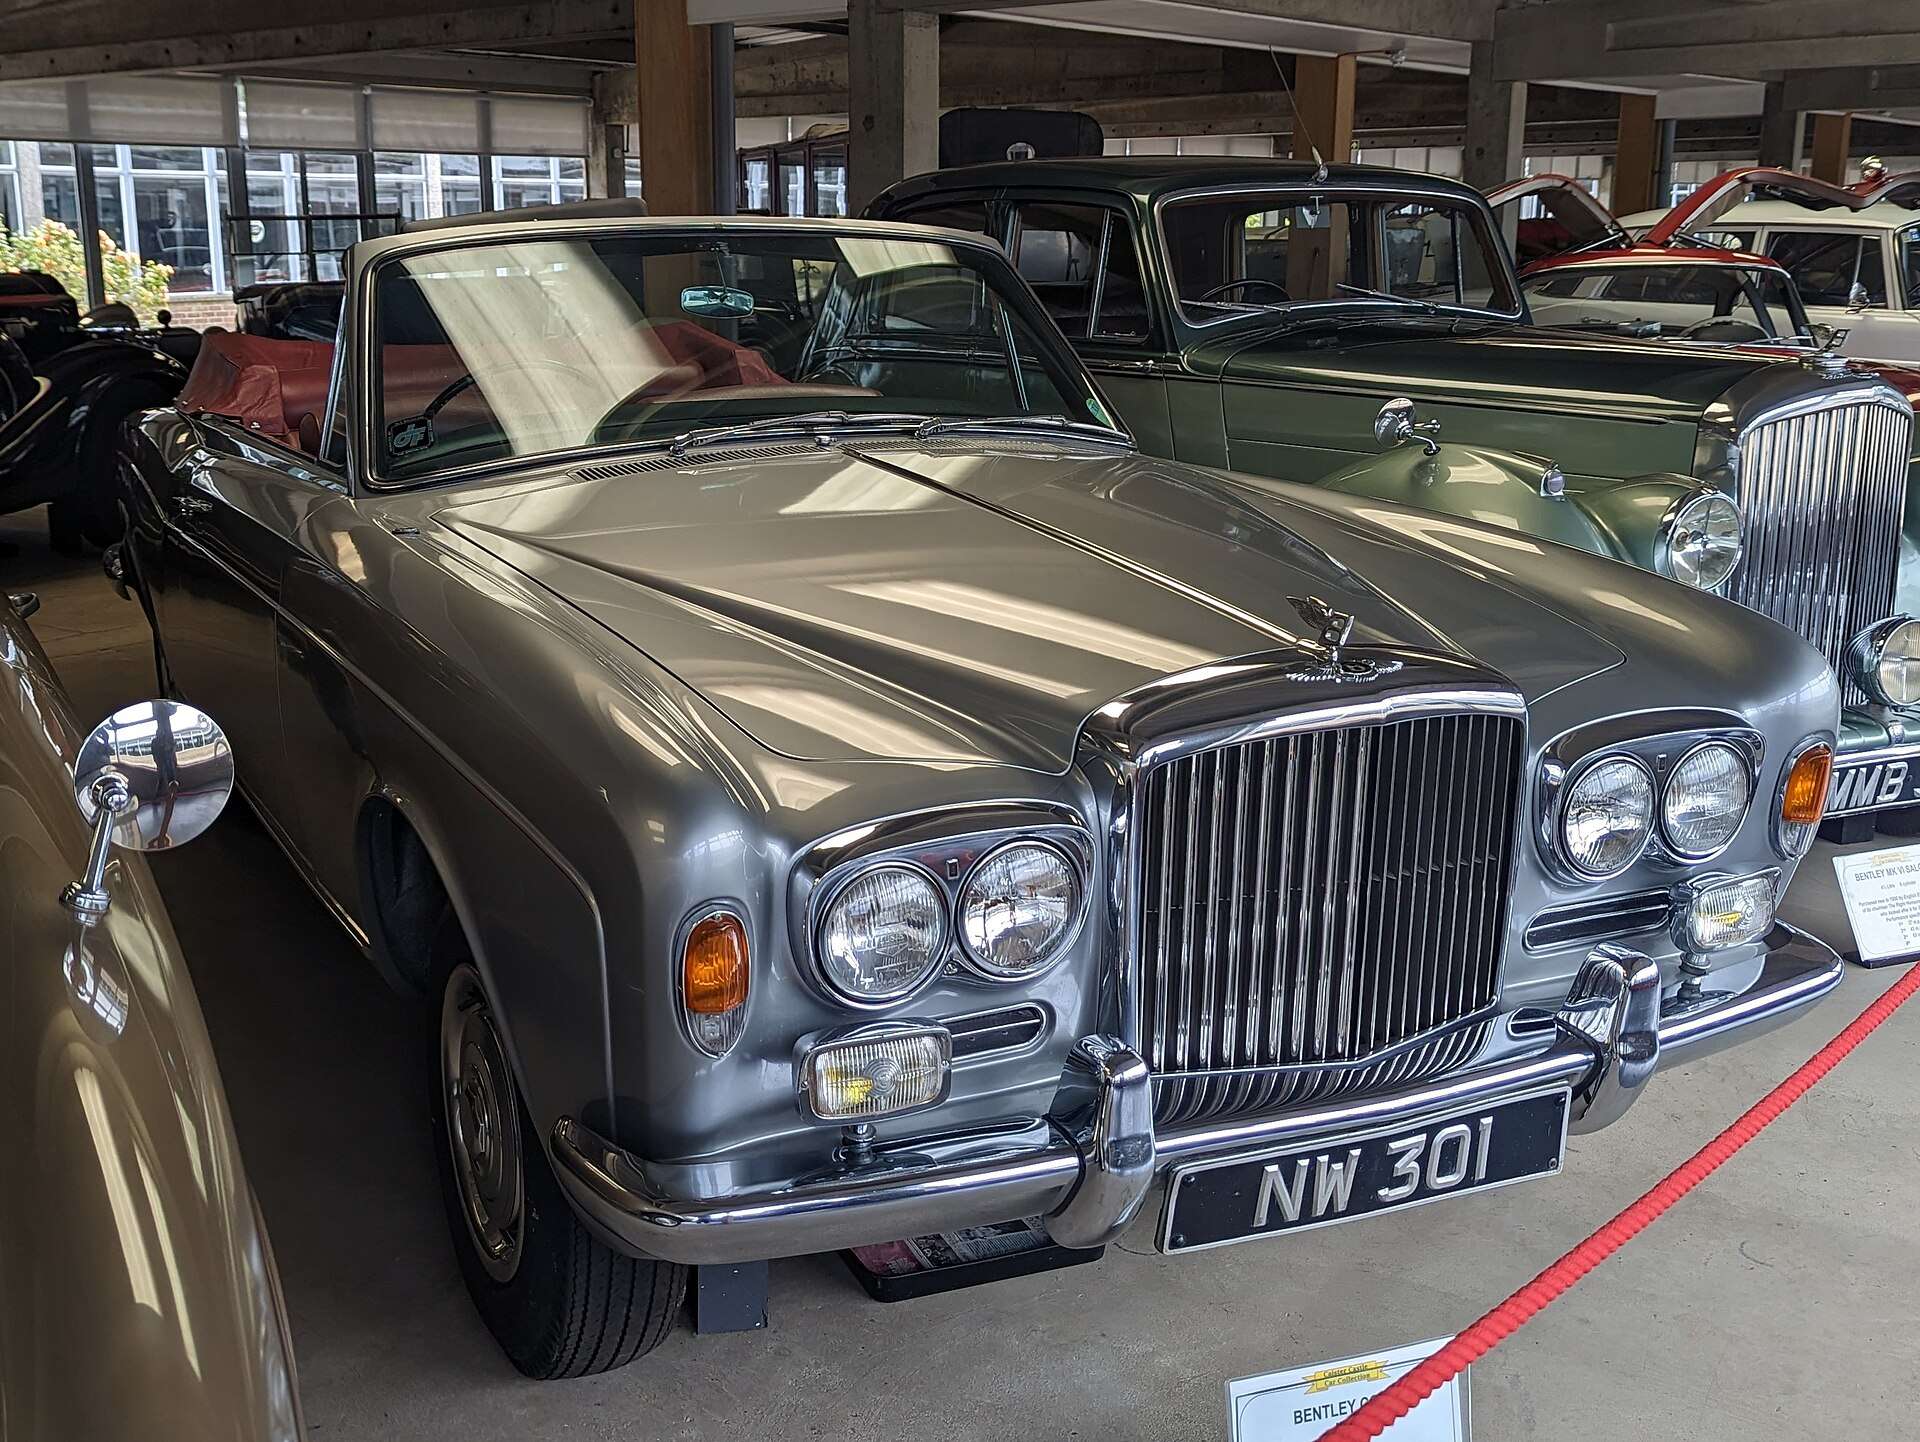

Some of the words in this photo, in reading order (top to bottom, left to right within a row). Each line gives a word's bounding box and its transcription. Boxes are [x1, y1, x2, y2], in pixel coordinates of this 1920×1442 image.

[1855, 869, 1885, 882] BENTLEY
[1886, 866, 1898, 876] MK
[1252, 1148, 1362, 1228] NW
[1377, 1115, 1495, 1202] 301
[1337, 1373, 1371, 1385] Collection
[1293, 1399, 1356, 1425] BENTLEY
